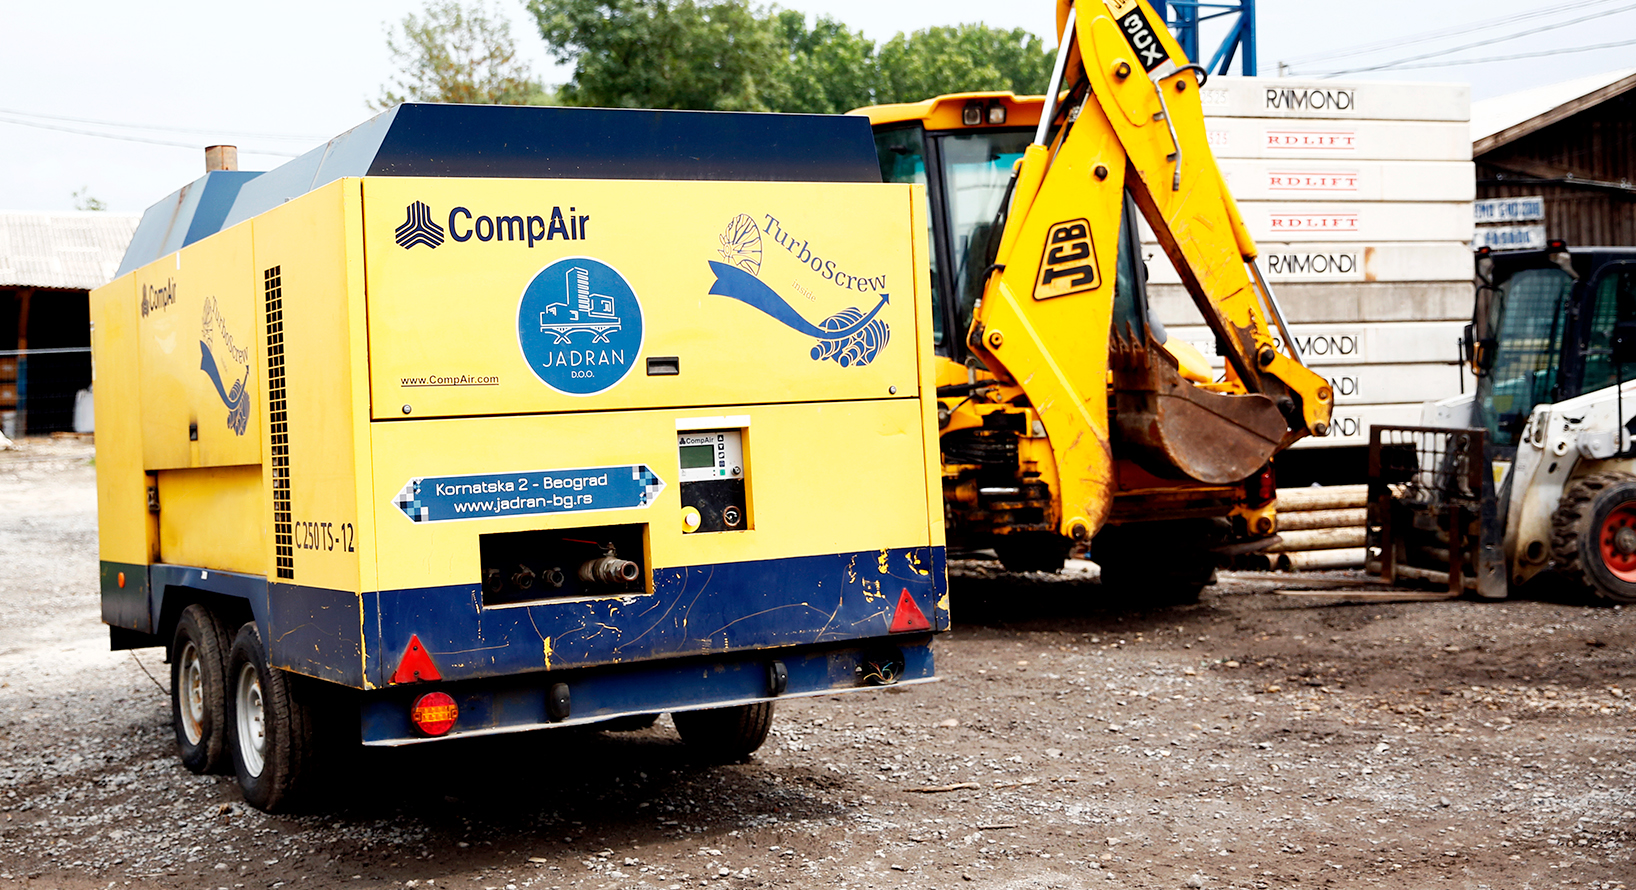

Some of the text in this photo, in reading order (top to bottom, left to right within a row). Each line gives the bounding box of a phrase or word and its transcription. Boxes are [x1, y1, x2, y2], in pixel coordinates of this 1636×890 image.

[1266, 89, 1355, 110] RAIMONDI
[1268, 135, 1356, 146] RDLIFT
[1269, 177, 1358, 187] RDLIFT
[447, 205, 590, 249] CompAir
[1271, 218, 1359, 228] RDLIFT
[762, 213, 887, 293] TurboScrew
[1041, 222, 1094, 288] JCB
[1268, 254, 1357, 274] RAIMONDI
[148, 277, 177, 312] CompAir
[790, 278, 818, 303] inside
[211, 295, 249, 364] TurboScrew
[542, 349, 625, 368] JADRAN
[400, 373, 500, 387] www.CompAir.com
[571, 369, 595, 379] D.O.O.
[685, 436, 715, 445] CompAir
[435, 479, 515, 497] Kornatska
[518, 477, 529, 492] 2
[543, 473, 608, 491] Beograd
[453, 493, 593, 514] www.jadran-bg.rs
